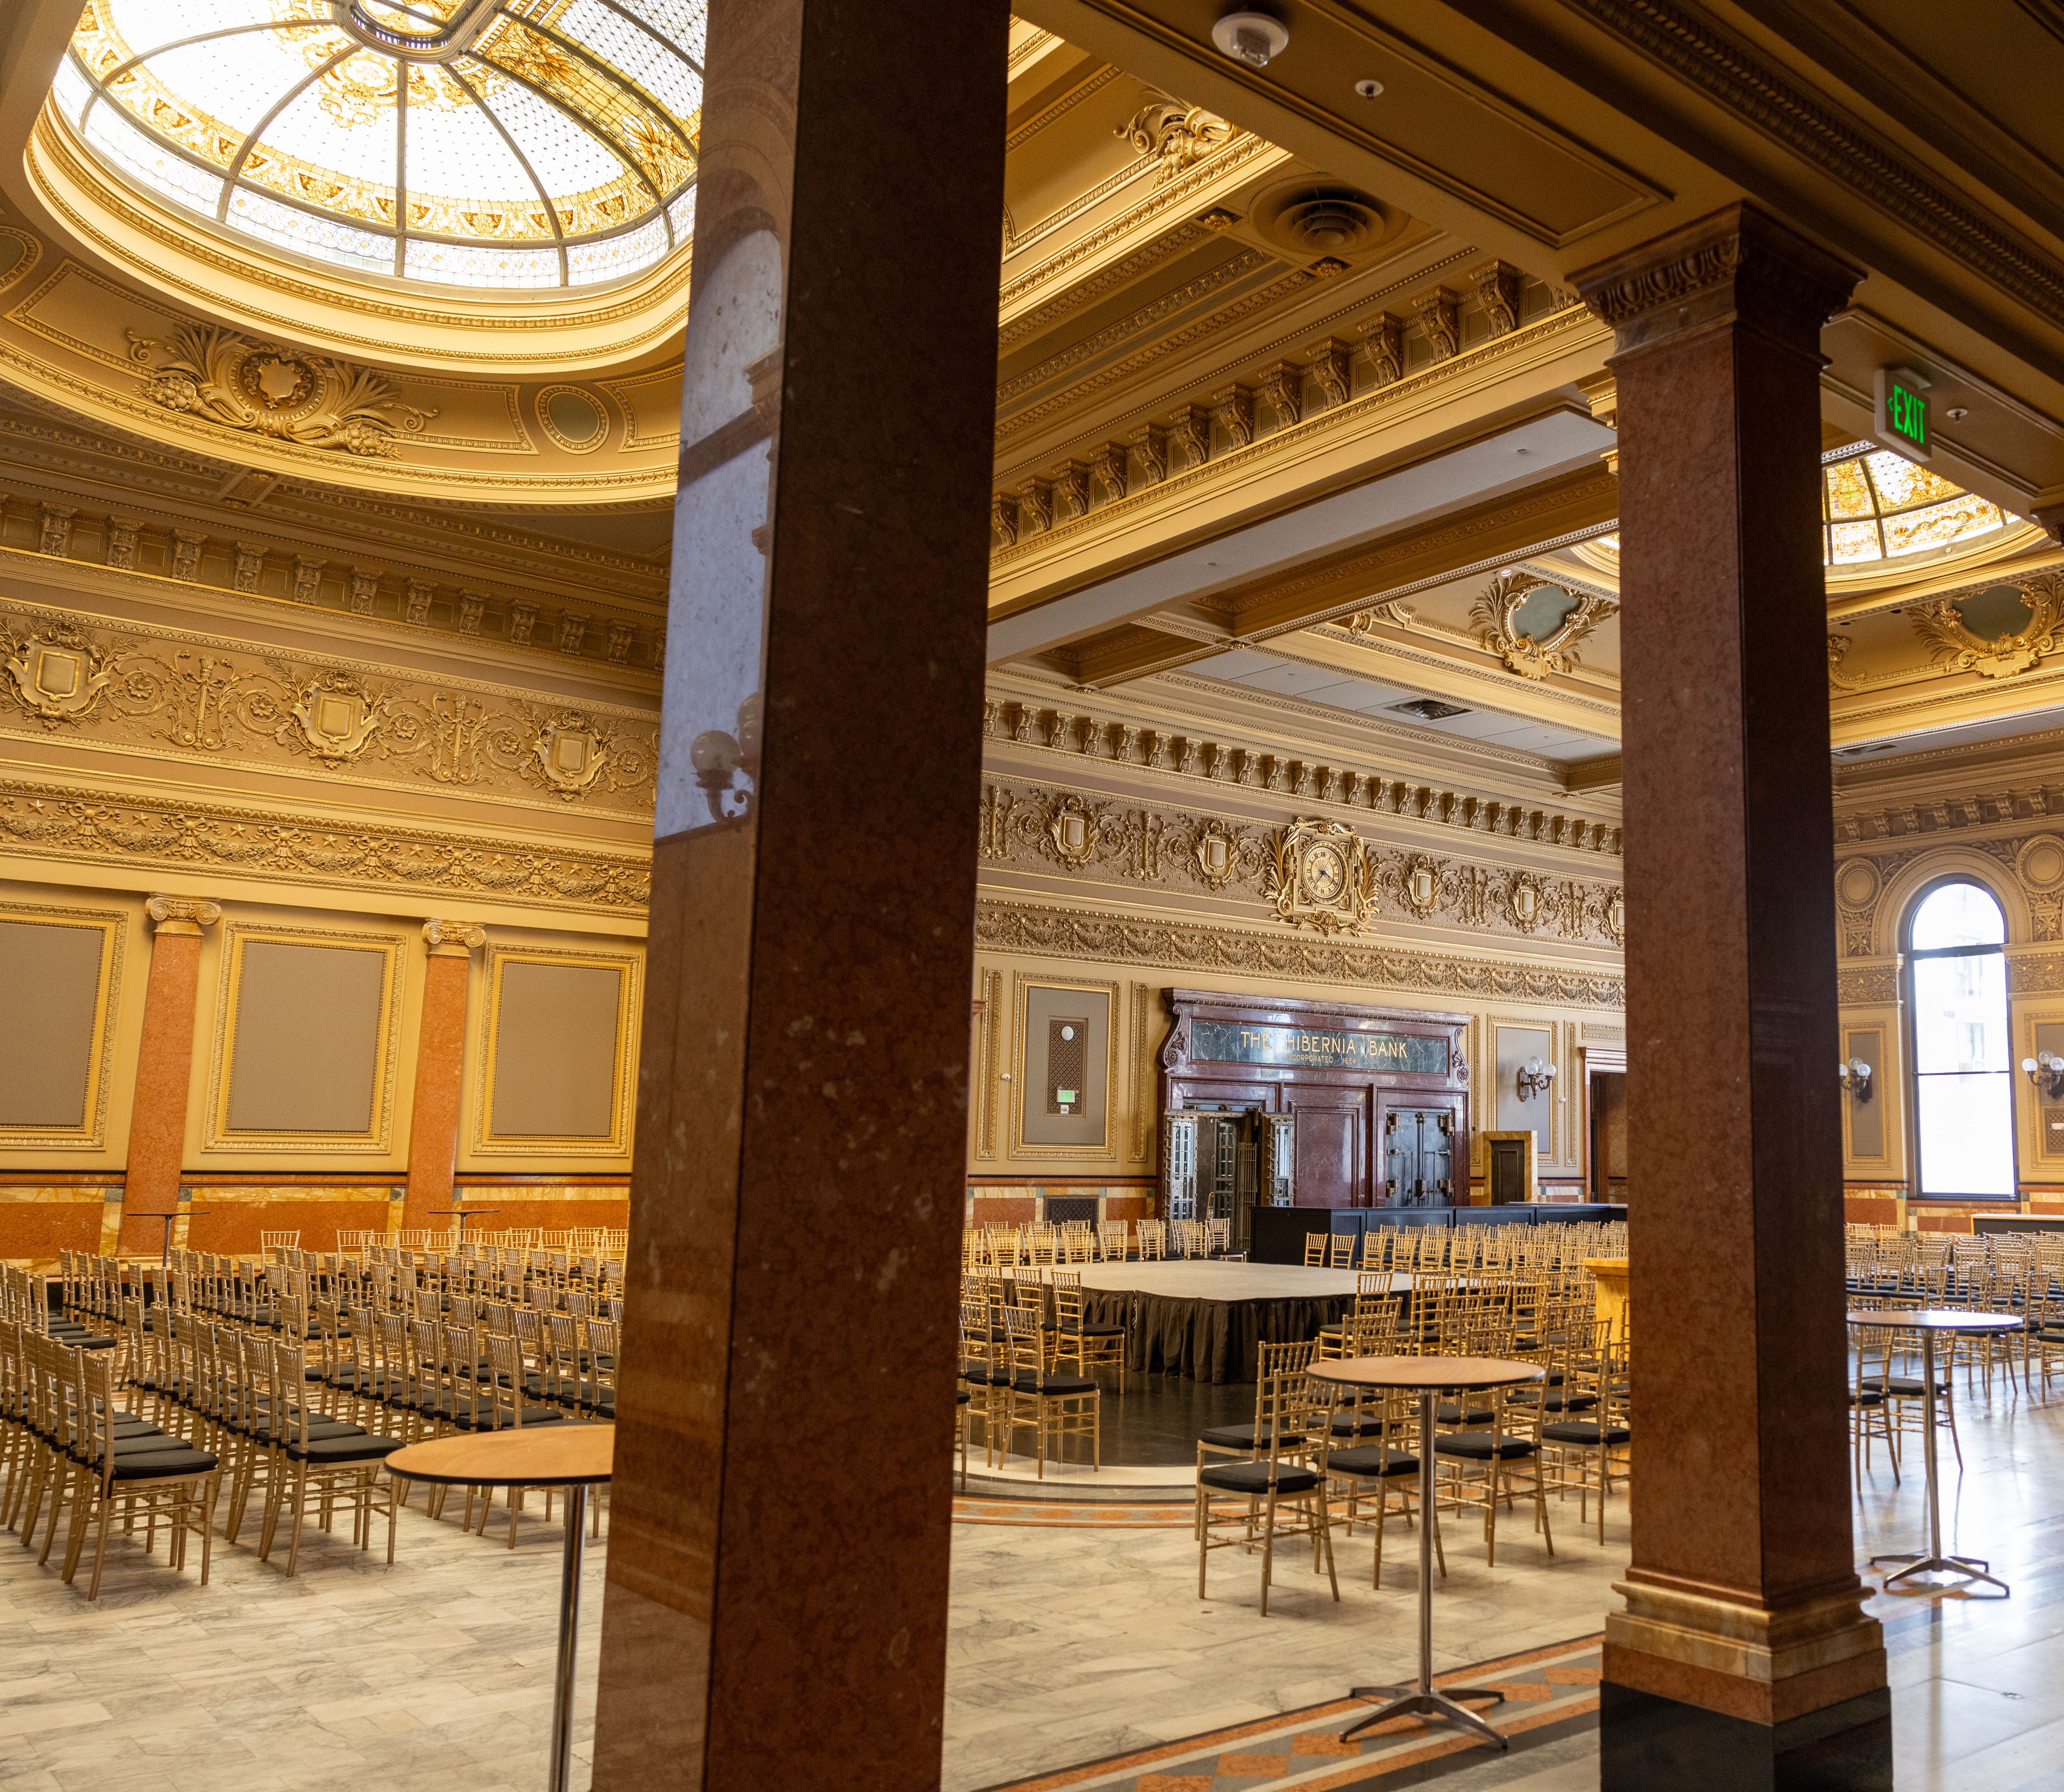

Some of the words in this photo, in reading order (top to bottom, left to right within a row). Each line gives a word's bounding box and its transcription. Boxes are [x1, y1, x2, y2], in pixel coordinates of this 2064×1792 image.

[1894, 385, 1925, 443] EXIT
[1240, 1031, 1272, 1049] THE
[1285, 1034, 1356, 1055] HIBERNIA
[1369, 1040, 1408, 1058] BANK
[1286, 1054, 1334, 1063] INCORPORATED
